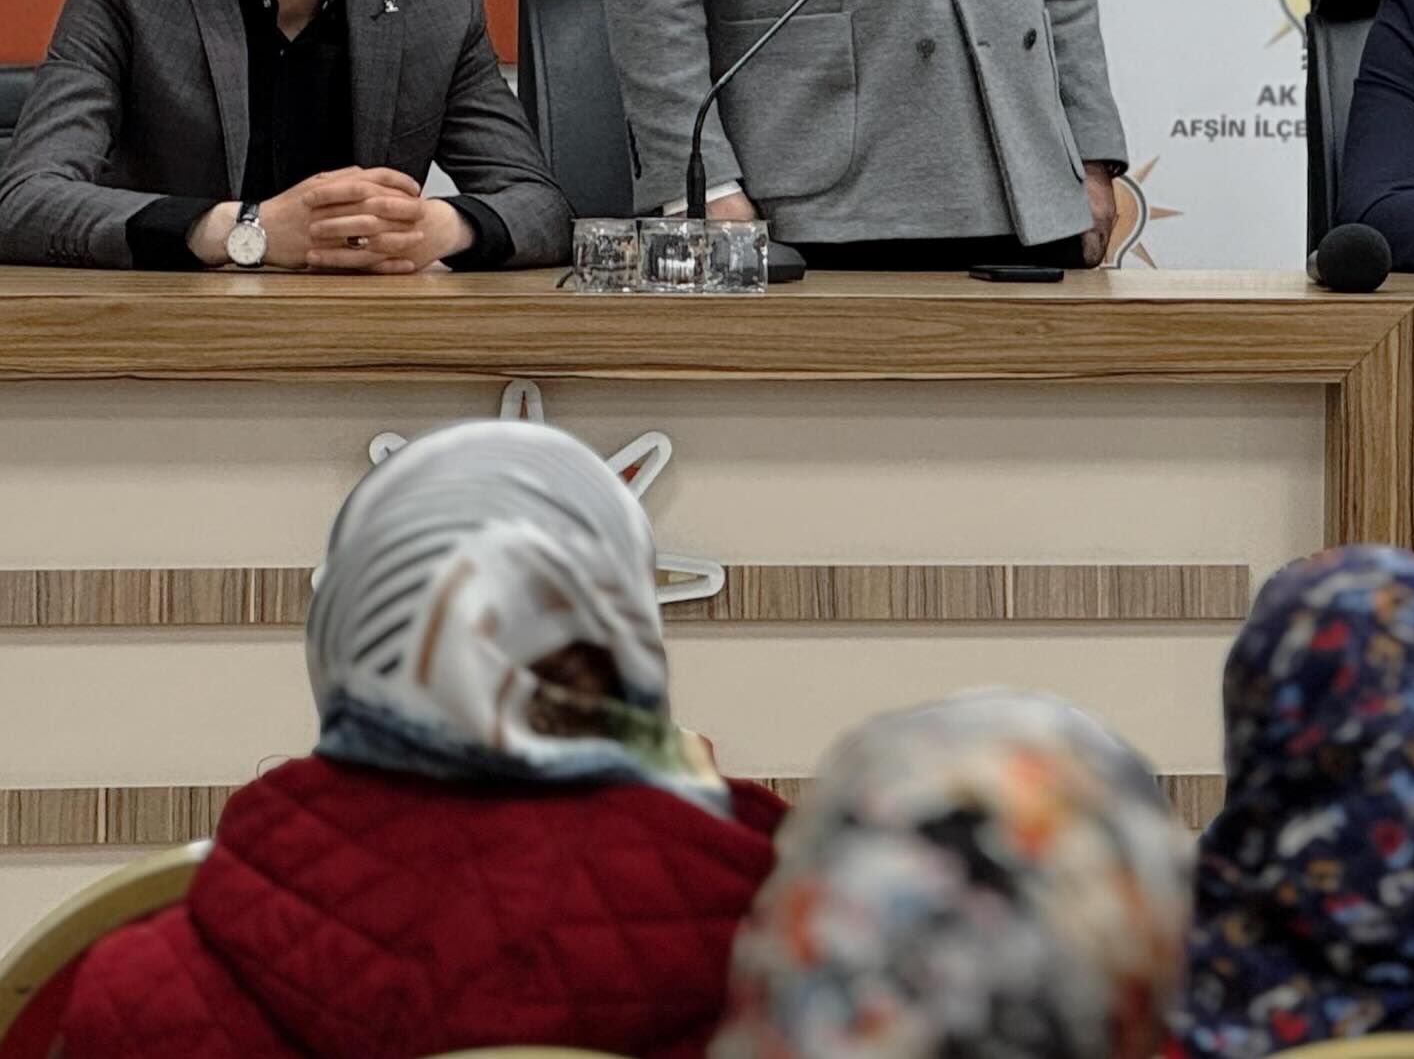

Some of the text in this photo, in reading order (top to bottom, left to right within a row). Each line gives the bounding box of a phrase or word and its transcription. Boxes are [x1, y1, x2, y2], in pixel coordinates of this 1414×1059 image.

[1256, 84, 1297, 107] AK
[1170, 114, 1307, 142] AFŞİN İLÇE
